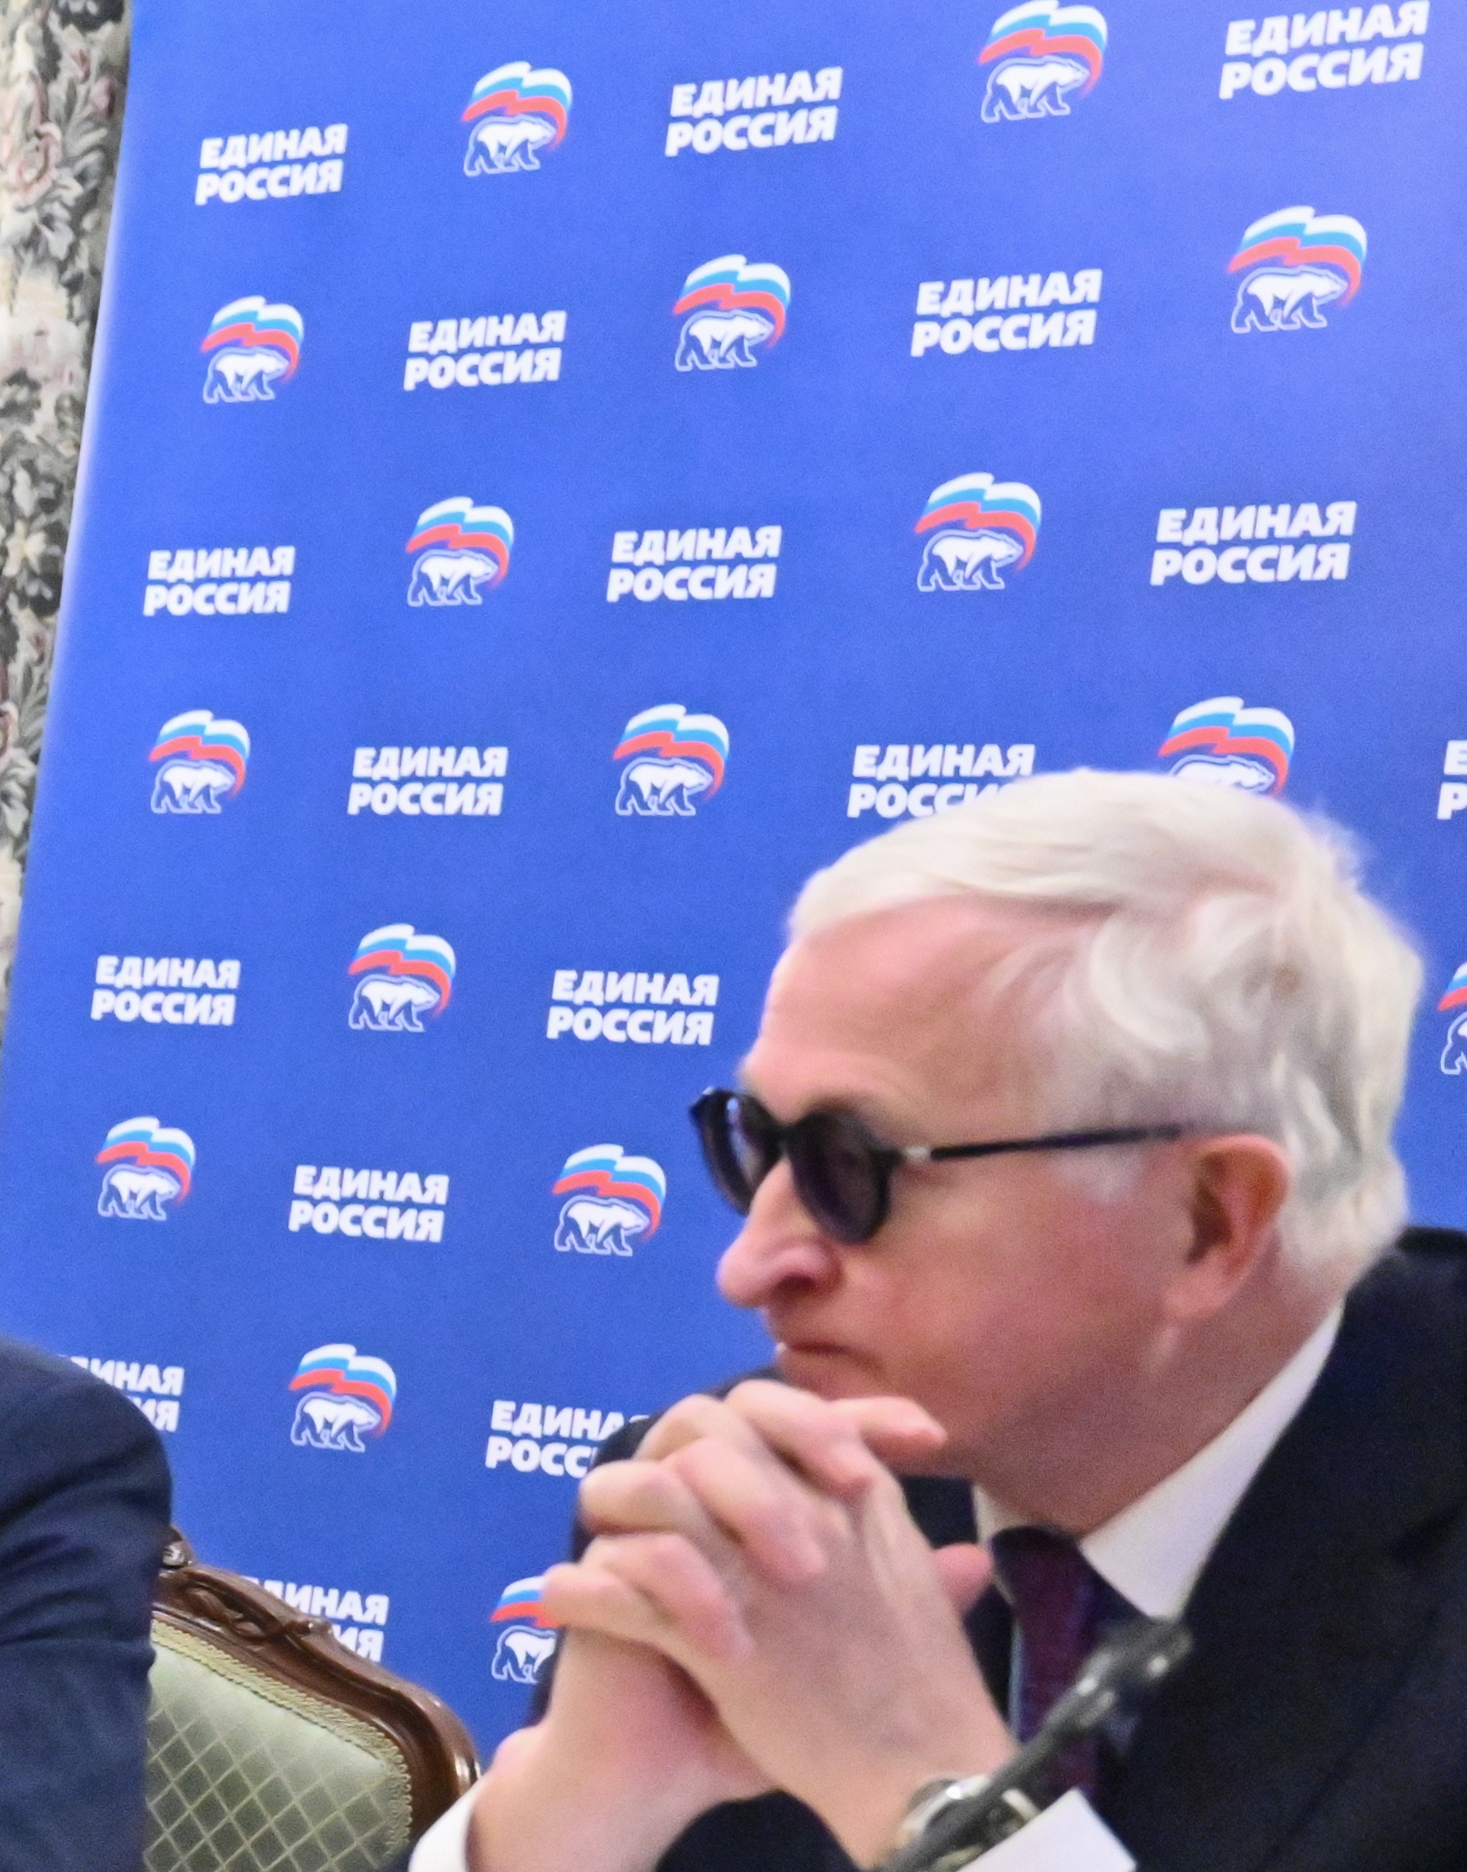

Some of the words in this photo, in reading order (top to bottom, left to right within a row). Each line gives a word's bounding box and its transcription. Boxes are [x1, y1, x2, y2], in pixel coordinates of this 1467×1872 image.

[1224, 0, 1431, 58] ЕДИНАЯ
[1218, 41, 1425, 100] РОССИЯ
[670, 66, 843, 119] ЕДИНАЯ
[199, 123, 348, 171] ЕДИНАЯ
[664, 105, 839, 157] РОССИЯ
[194, 159, 344, 206] РОССИЯ
[916, 268, 1103, 318] ЕДИНАЯ
[408, 310, 567, 355] ЕДИНАЯ
[910, 309, 1097, 357] РОССИЯ
[403, 347, 562, 391] РОССИЯ
[1156, 501, 1358, 546] ЕДИНАЯ
[147, 546, 296, 583] ЕДИНАЯ
[611, 525, 782, 566] ЕДИНАЯ
[1150, 542, 1351, 586] РОССИЯ
[143, 581, 291, 617] РОССИЯ
[606, 563, 777, 603] РОССИЯ
[352, 746, 509, 781] ЕДИНАЯ
[852, 744, 1036, 782] ЕДИНАЯ
[347, 782, 504, 816] РОССИЯ
[95, 955, 241, 990] ЕДИНАЯ
[551, 970, 720, 1006] ЕДИНАЯ
[90, 989, 236, 1026] РОССИЯ
[546, 1006, 714, 1046] РОССИЯ
[293, 1165, 450, 1205] ЕДИНАЯ
[288, 1200, 445, 1243] РОССИЯ
[70, 1356, 185, 1396] ИНАЯ
[490, 1399, 650, 1442] ЕДИНА
[485, 1436, 599, 1479] РОСС
[242, 1575, 390, 1627] ИНАЯ
